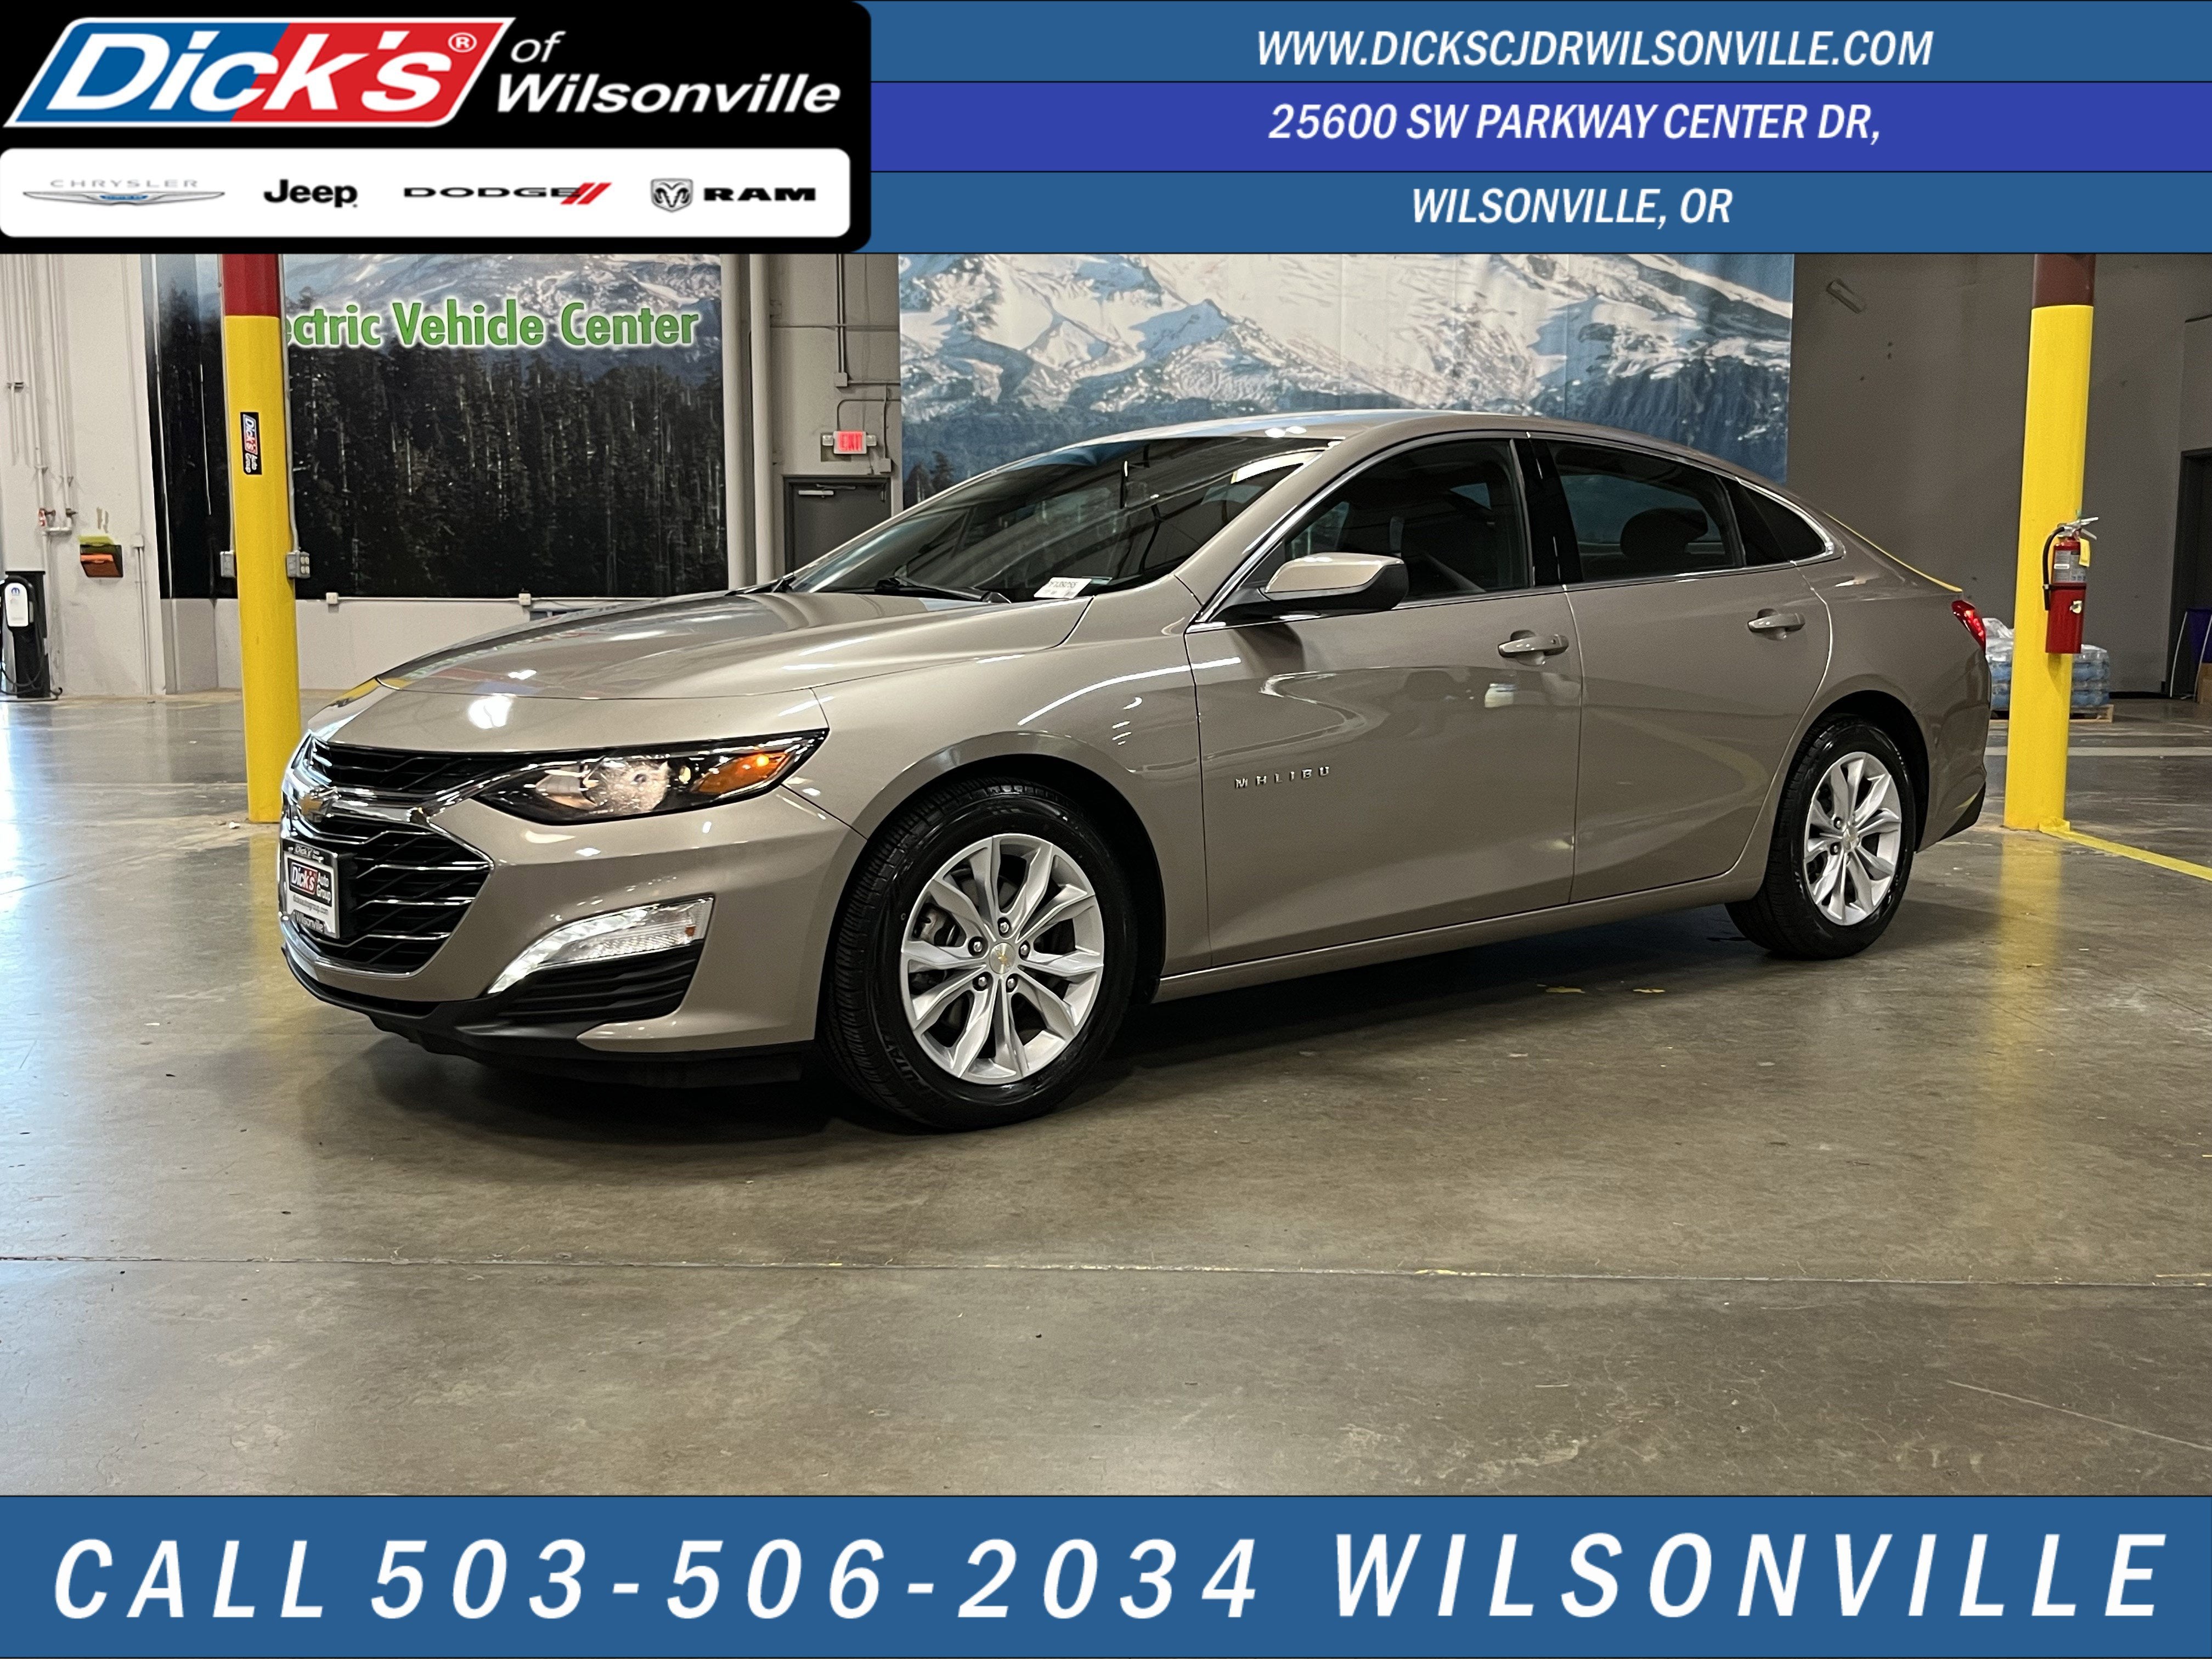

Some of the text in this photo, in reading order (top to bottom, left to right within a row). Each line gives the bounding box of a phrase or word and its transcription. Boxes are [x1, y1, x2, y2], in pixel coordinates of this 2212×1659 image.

[392, 300, 543, 345] Vehicle
[561, 302, 698, 345] Center
[1235, 765, 1330, 789] MALIBU
[291, 865, 315, 891] Dick's
